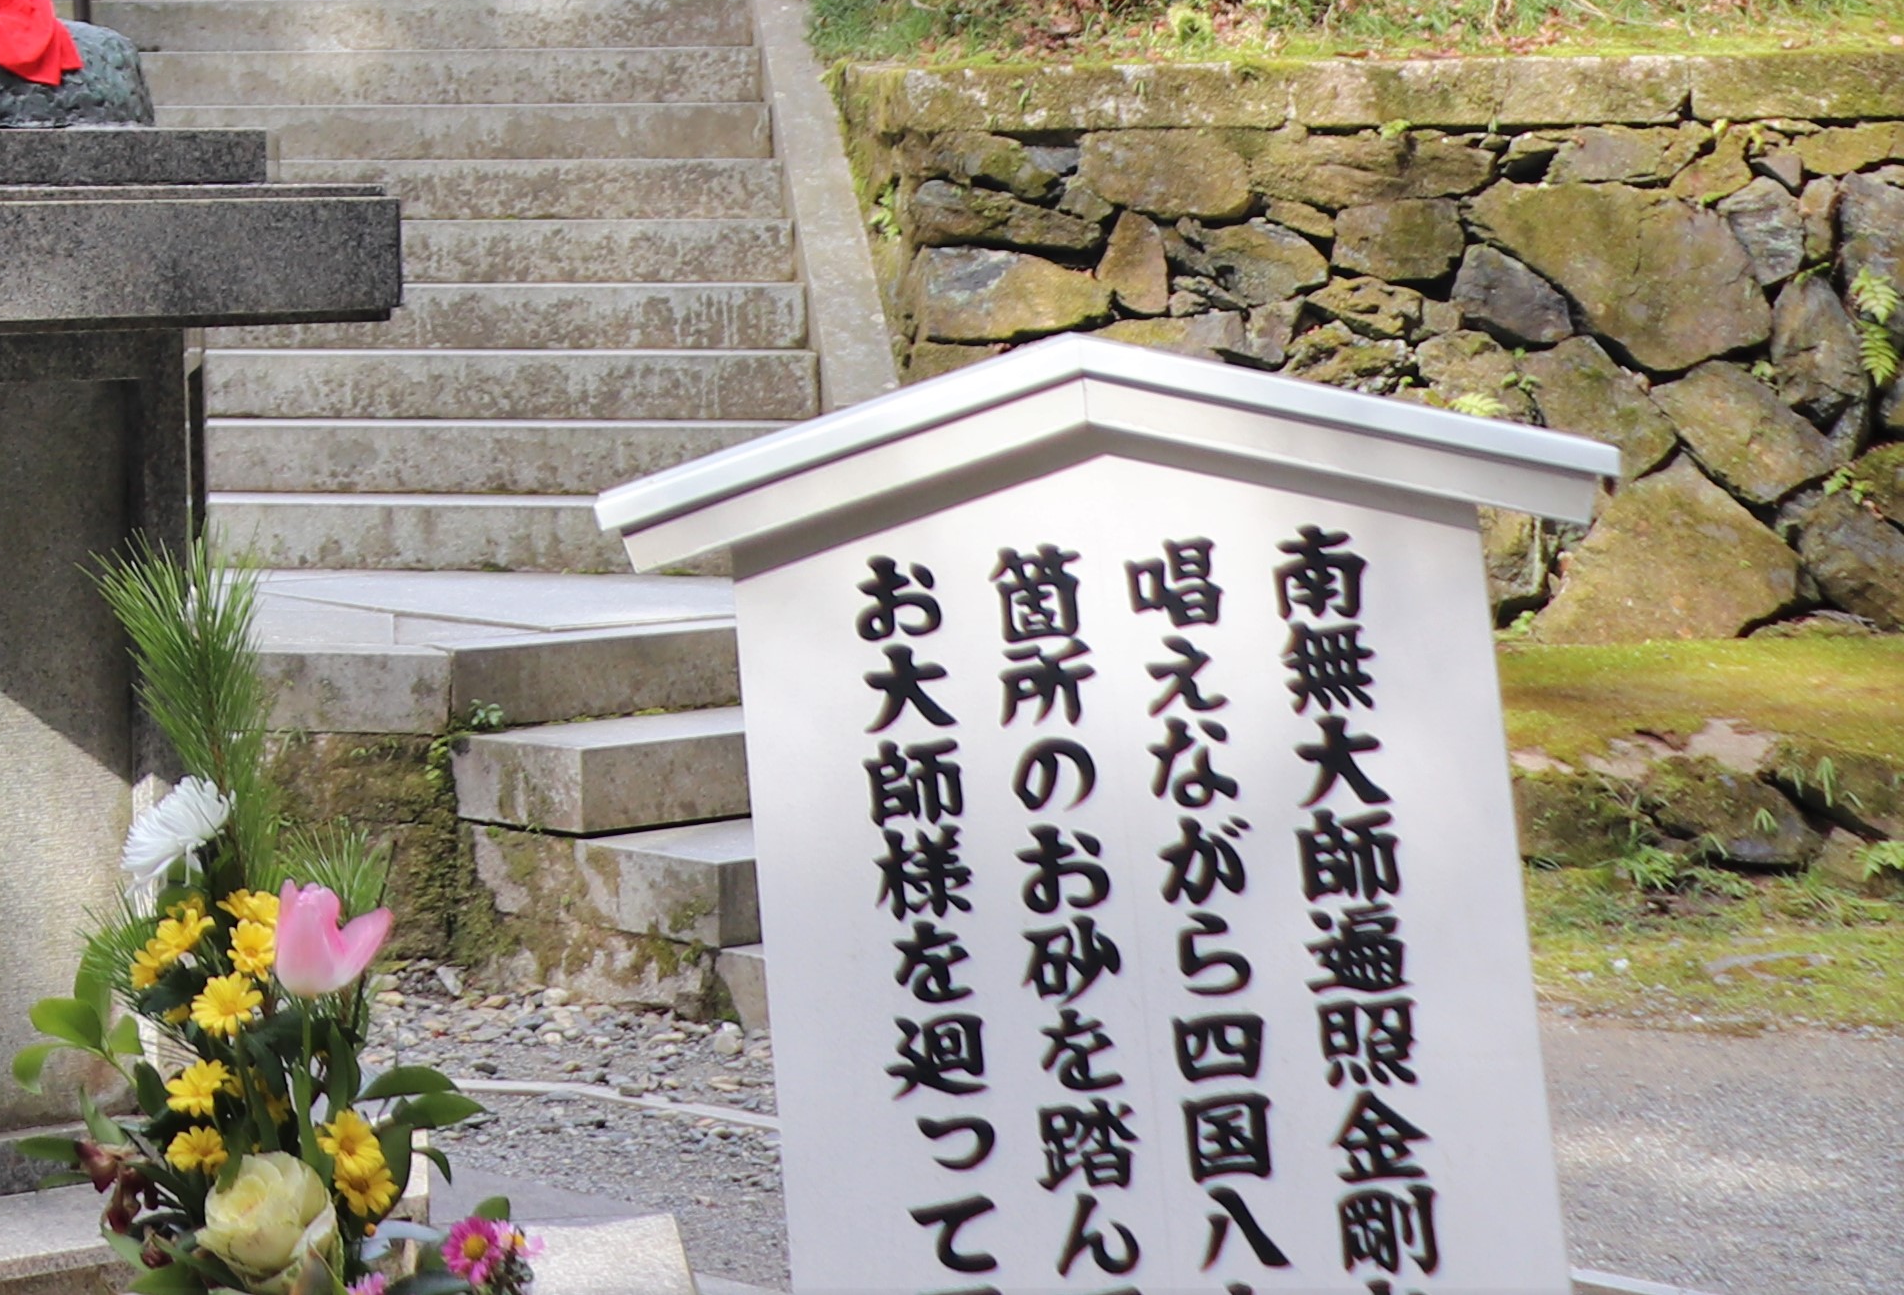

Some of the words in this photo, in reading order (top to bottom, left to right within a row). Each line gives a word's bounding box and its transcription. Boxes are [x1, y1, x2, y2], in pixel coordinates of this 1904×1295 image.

[855, 555, 999, 1295] お大師様を廻って
[989, 544, 1143, 1295] 箇所のお砂を踏ん
[1125, 537, 1291, 1295] 唱えながら四国八
[1272, 524, 1442, 1295] 南無大師遍照金剛
